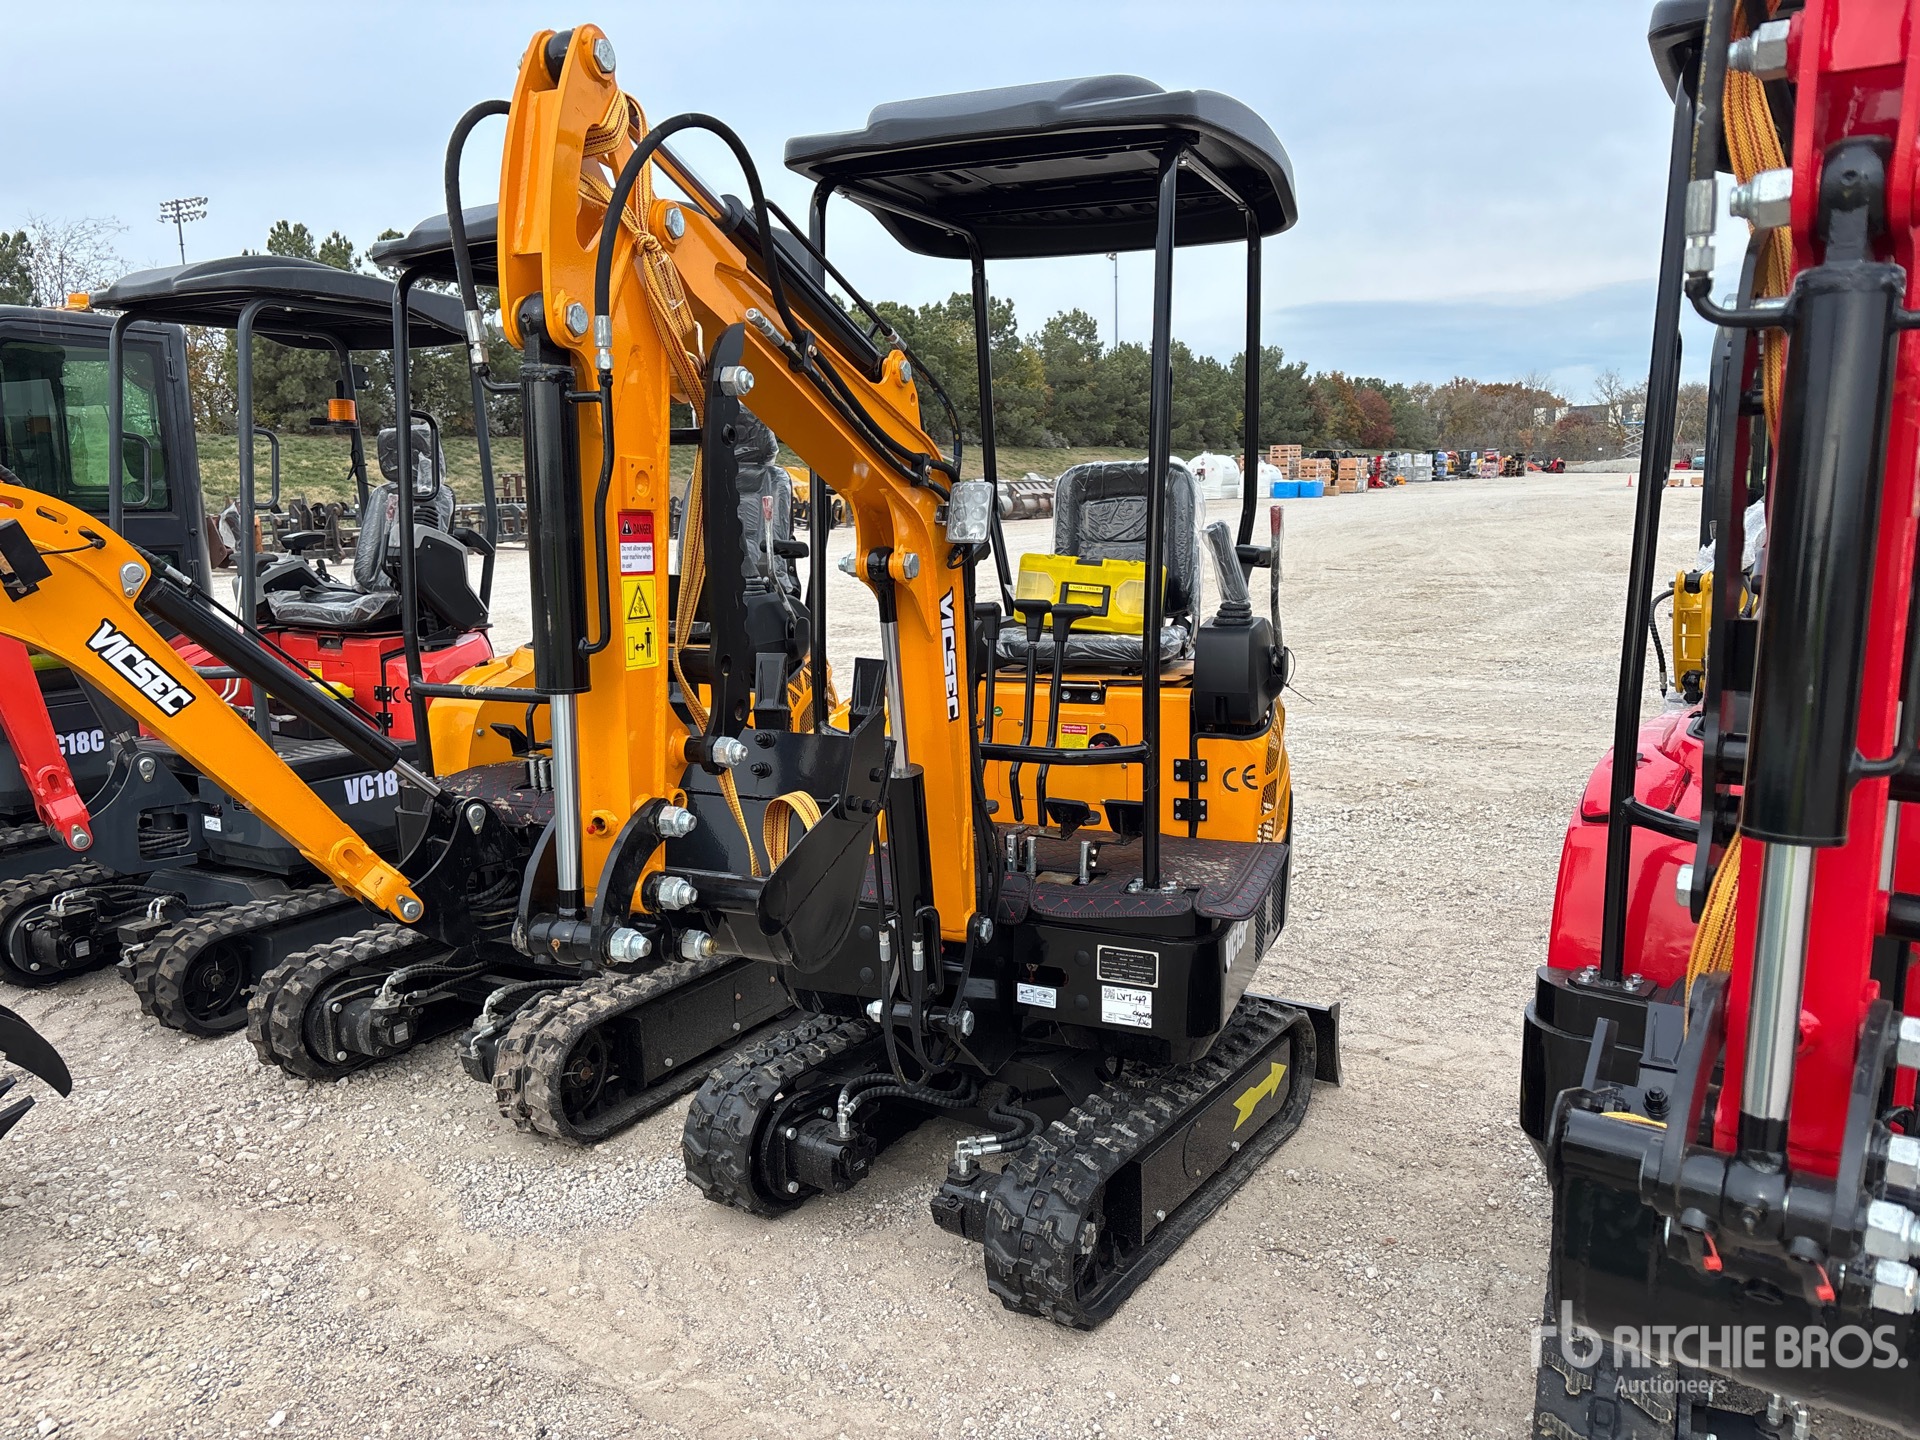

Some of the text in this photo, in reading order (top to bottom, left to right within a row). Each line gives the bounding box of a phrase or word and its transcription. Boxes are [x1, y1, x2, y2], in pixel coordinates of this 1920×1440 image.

[633, 524, 651, 534] DANGER
[86, 618, 196, 717] VICSEC
[939, 586, 960, 722] VICSEC
[56, 729, 105, 756] C18C
[1223, 764, 1258, 792] CE
